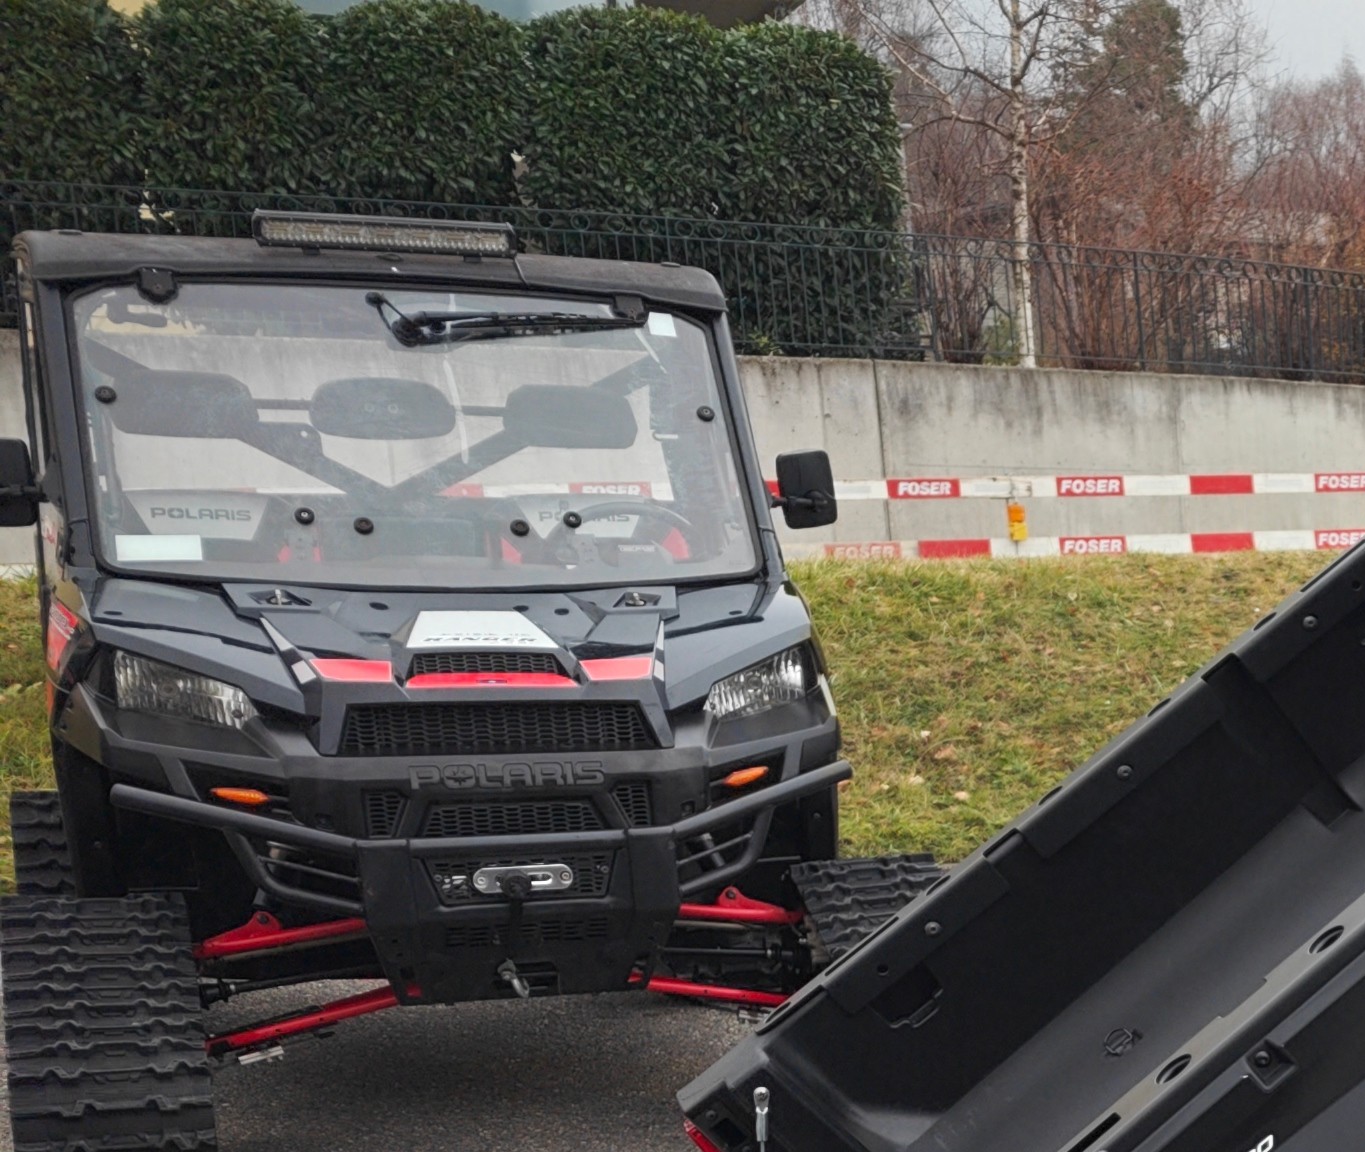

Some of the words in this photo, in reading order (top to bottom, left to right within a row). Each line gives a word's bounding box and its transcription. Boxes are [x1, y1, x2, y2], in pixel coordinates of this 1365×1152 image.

[897, 481, 952, 496] FOSER
[1060, 478, 1121, 495] FOSER
[150, 506, 252, 522] POLARIS
[832, 545, 896, 558] FOSER
[1063, 538, 1122, 553] FOSER
[408, 760, 605, 790] POLARIS
